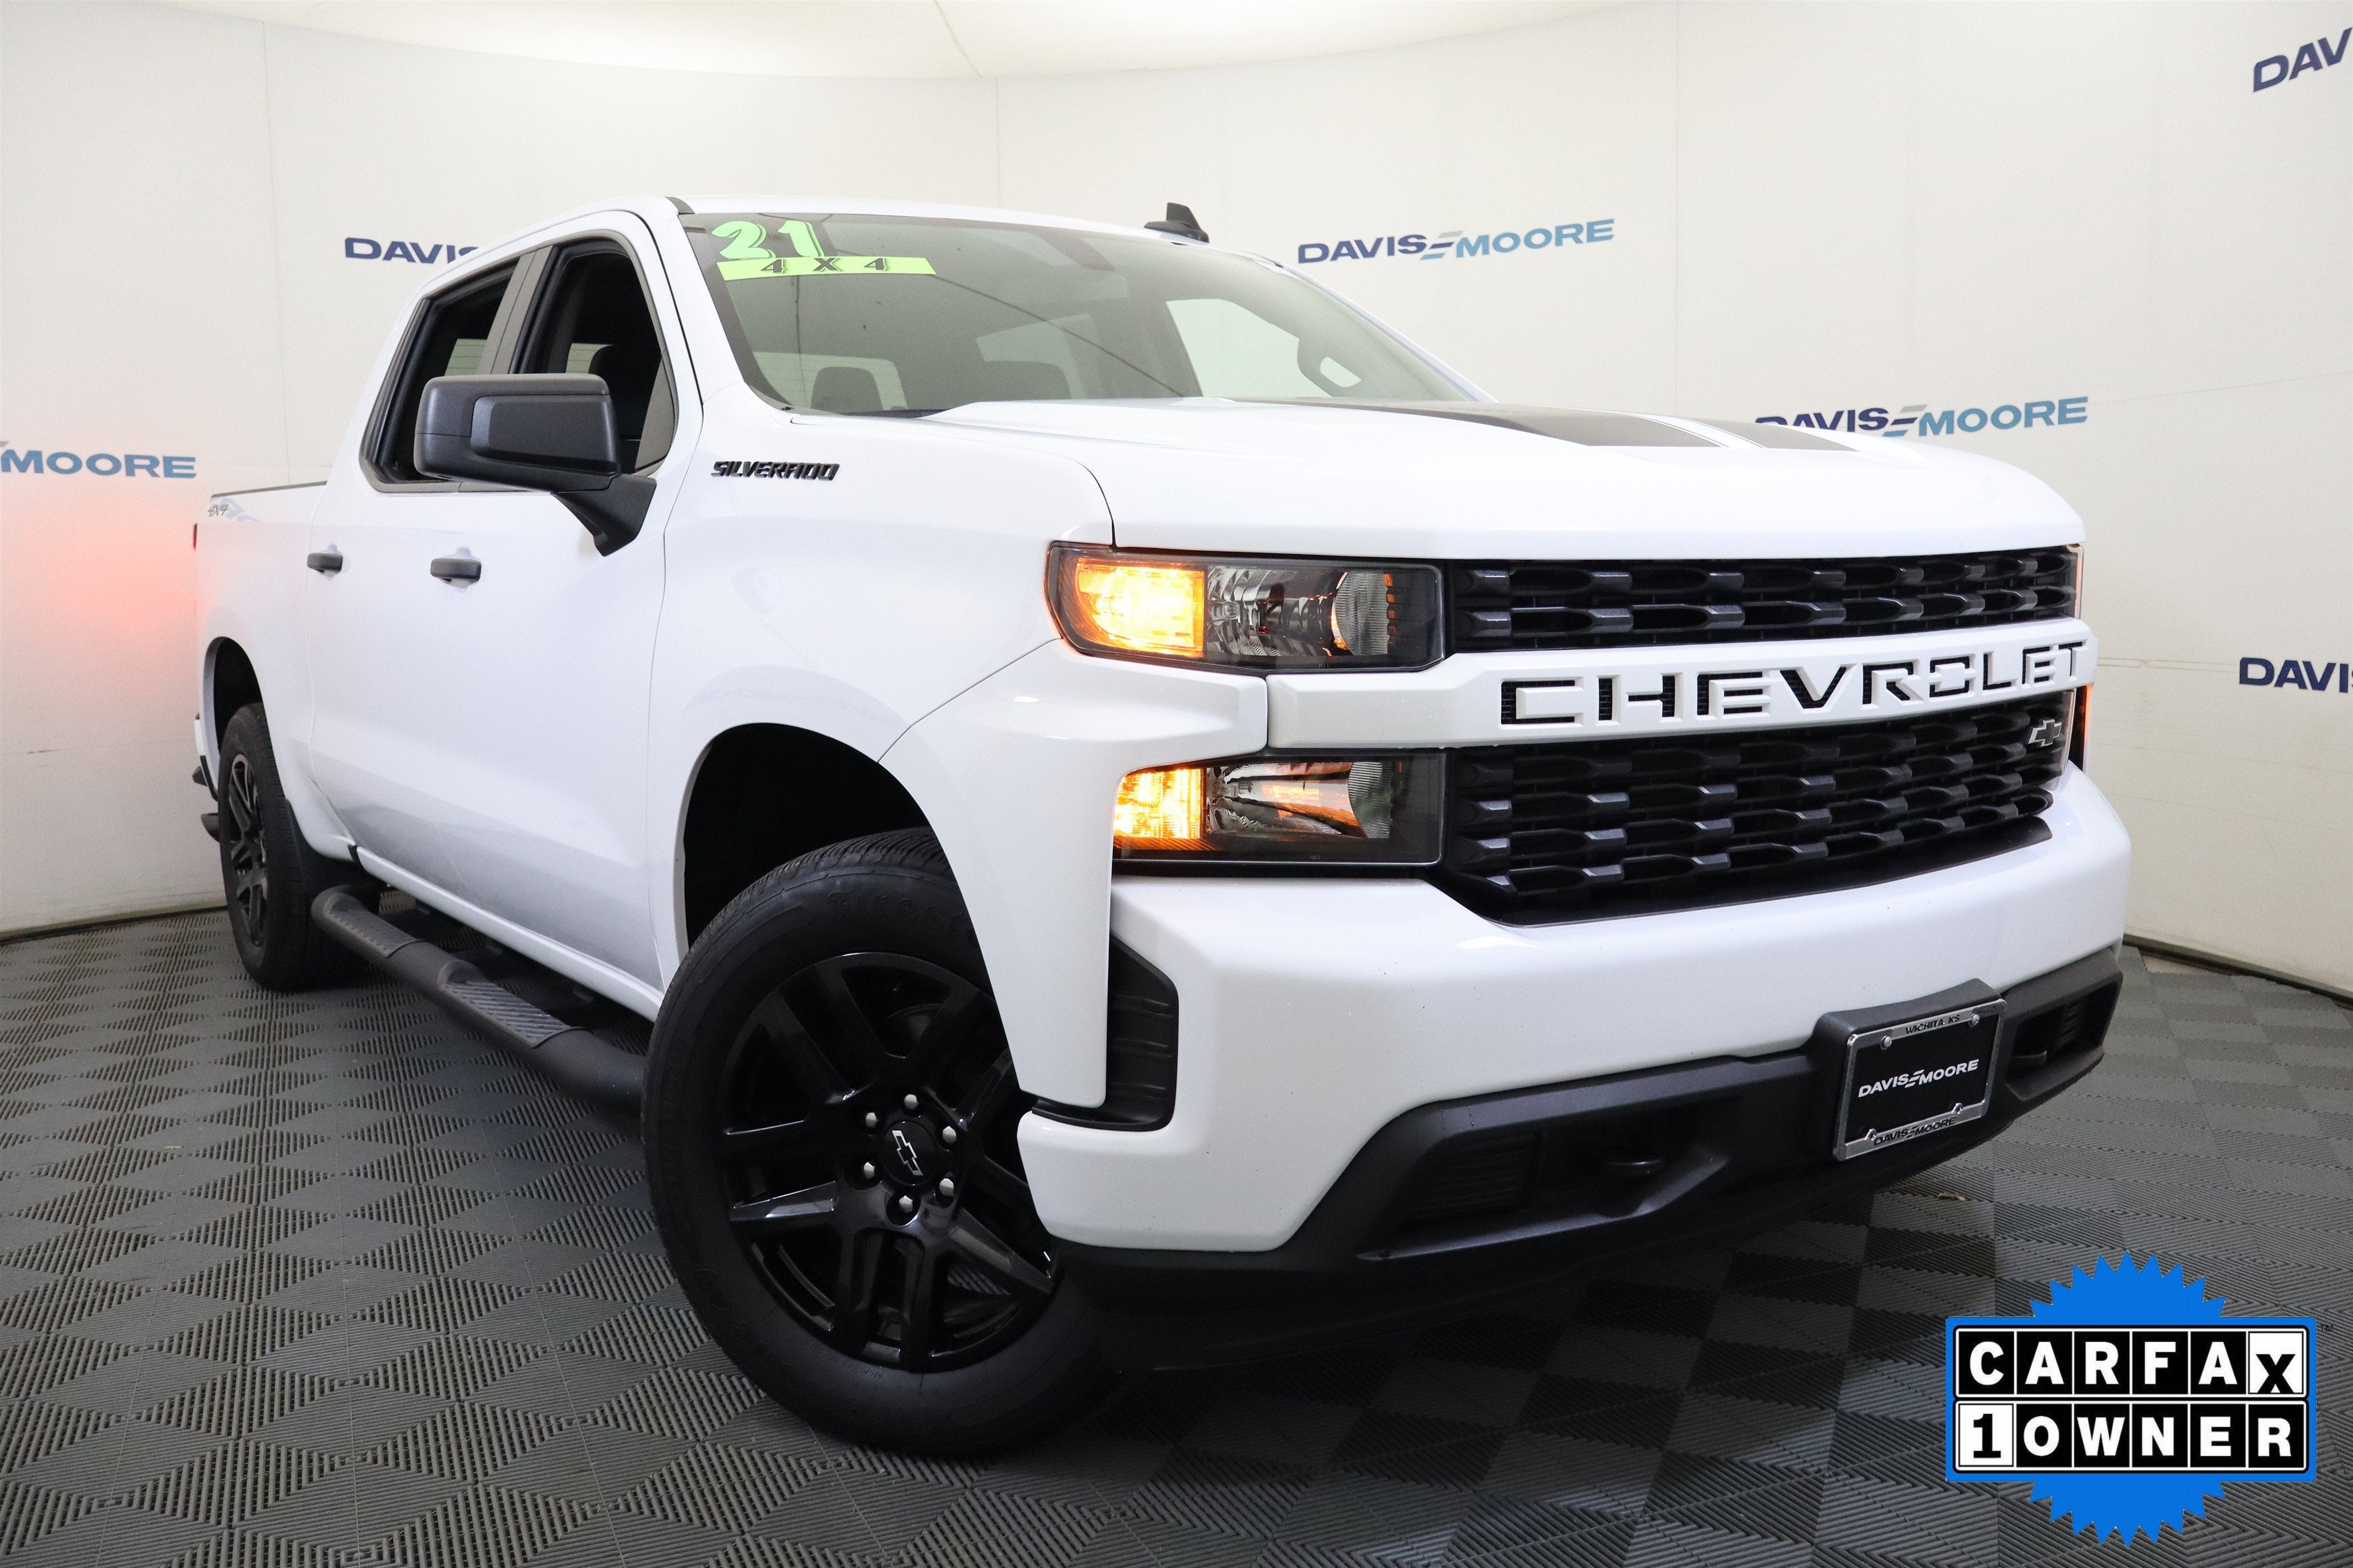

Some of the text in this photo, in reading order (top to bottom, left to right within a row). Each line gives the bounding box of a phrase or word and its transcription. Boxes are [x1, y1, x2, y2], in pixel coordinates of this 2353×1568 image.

[712, 219, 824, 259] 21
[1298, 219, 1615, 264] DAVIS MOORE
[1919, 396, 2089, 437] MOORE
[1, 449, 197, 478] MOORE
[711, 461, 840, 481] SILVERADO
[1500, 639, 2089, 727] CHEVROLET
[2239, 657, 2353, 693] DAVI
[1948, 1014, 1960, 1024] KS
[1858, 1059, 1979, 1098] DAVIS MOORE
[1874, 1117, 1957, 1145] DAVIS MOORE
